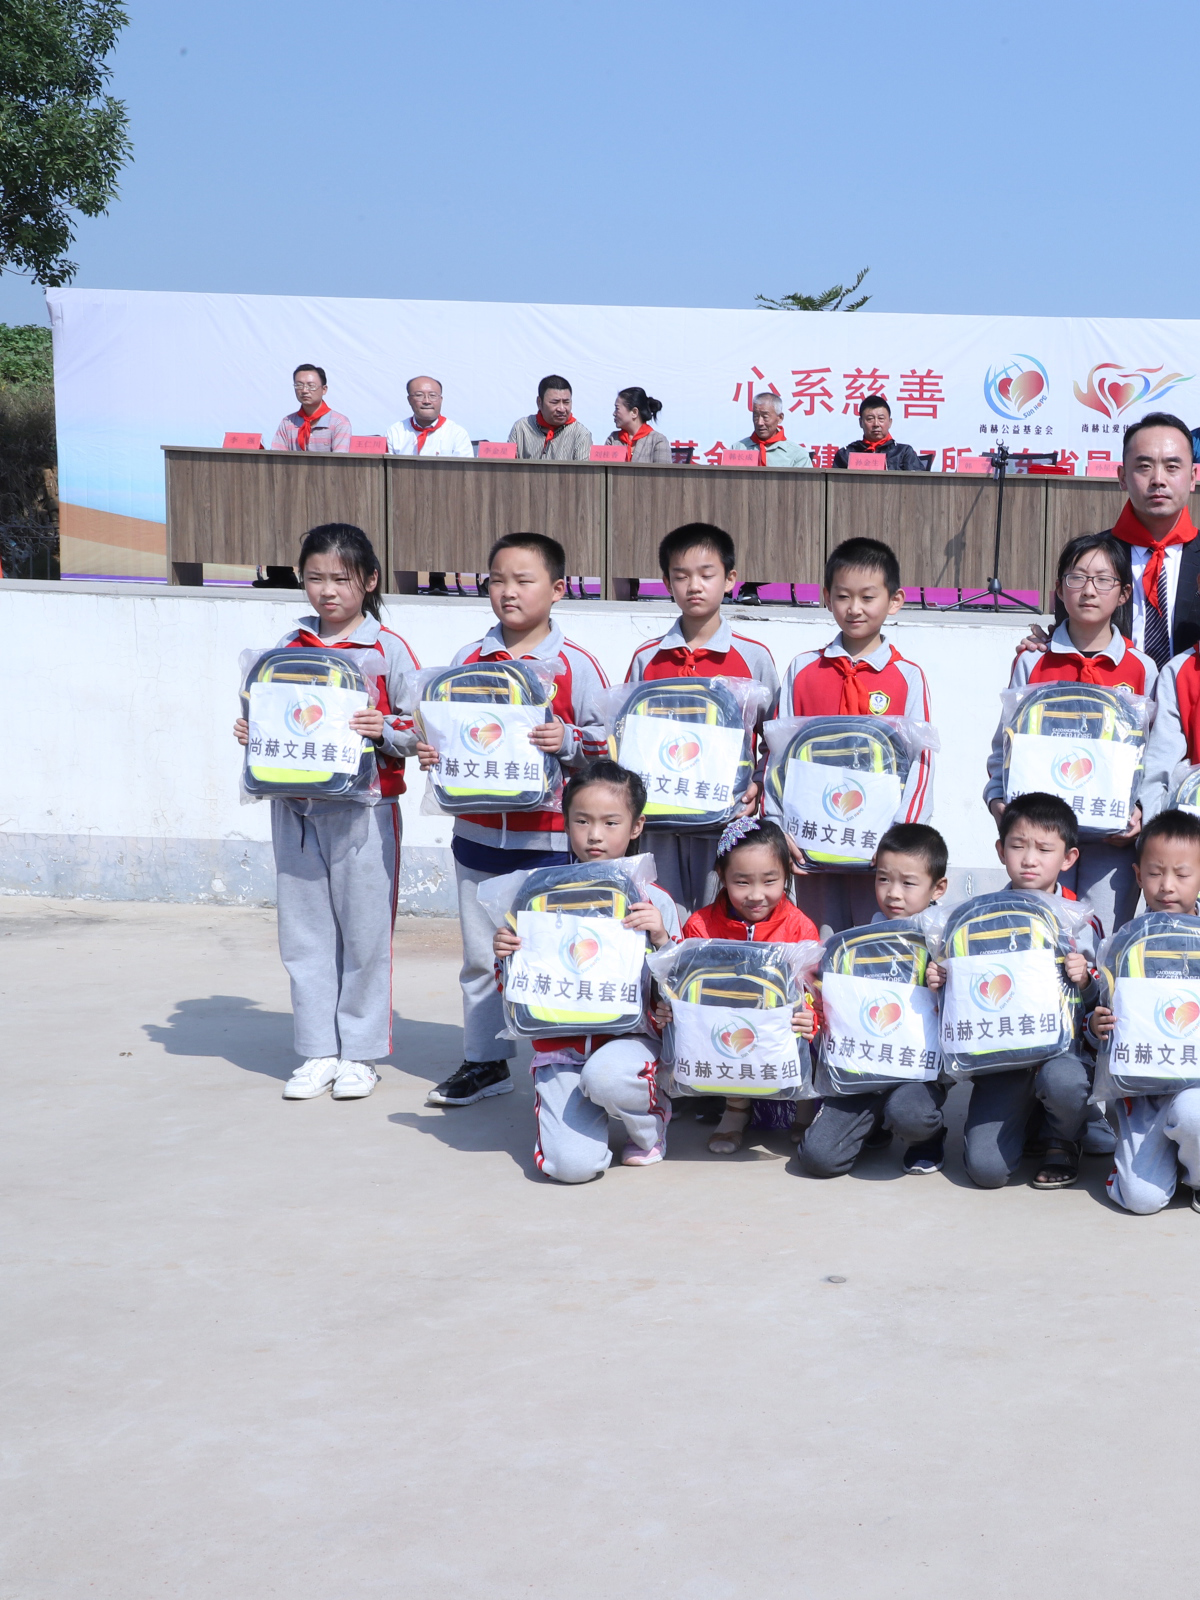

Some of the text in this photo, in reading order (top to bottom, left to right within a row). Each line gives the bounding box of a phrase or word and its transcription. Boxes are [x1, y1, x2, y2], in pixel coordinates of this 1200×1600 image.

[732, 365, 945, 419] 心系慈善
[979, 424, 1053, 436] 尚赫公益基金会
[249, 737, 357, 764] 尚赫文具套组
[640, 771, 730, 803] 赫文具套组
[786, 816, 880, 850] 尚赫文具套
[512, 971, 638, 1002] 尚赫文具套组
[944, 1012, 1057, 1042] 尚赫文具套组
[677, 1057, 798, 1081] 尚赫文具套组
